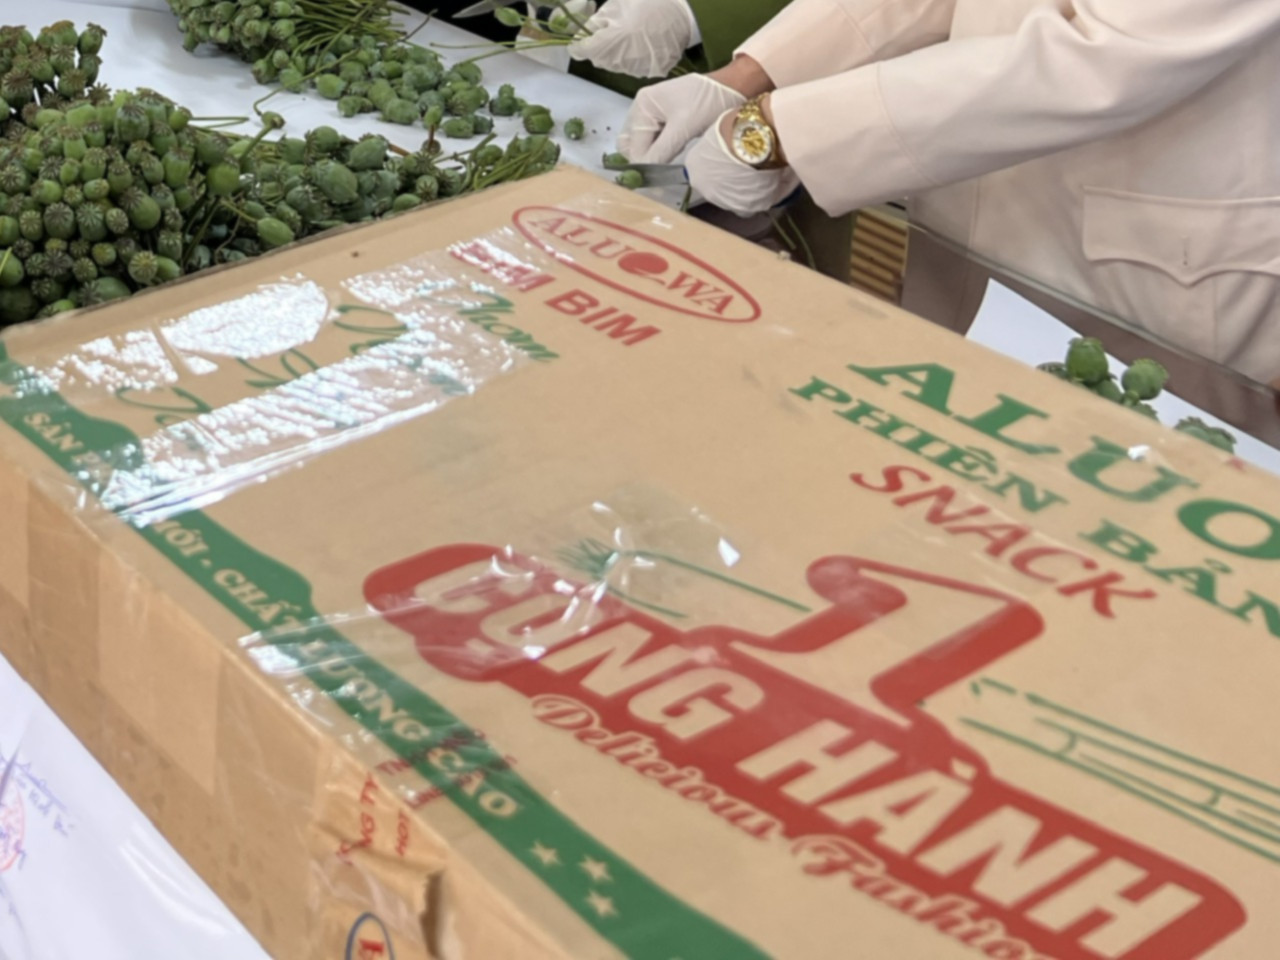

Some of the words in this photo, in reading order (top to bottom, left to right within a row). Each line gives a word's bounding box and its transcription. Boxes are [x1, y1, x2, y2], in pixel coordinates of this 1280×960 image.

[544, 288, 662, 346] BIM
[788, 375, 1069, 513] PHIÊN
[849, 464, 1158, 620] SNACK
[734, 717, 1205, 960] HÀNH
